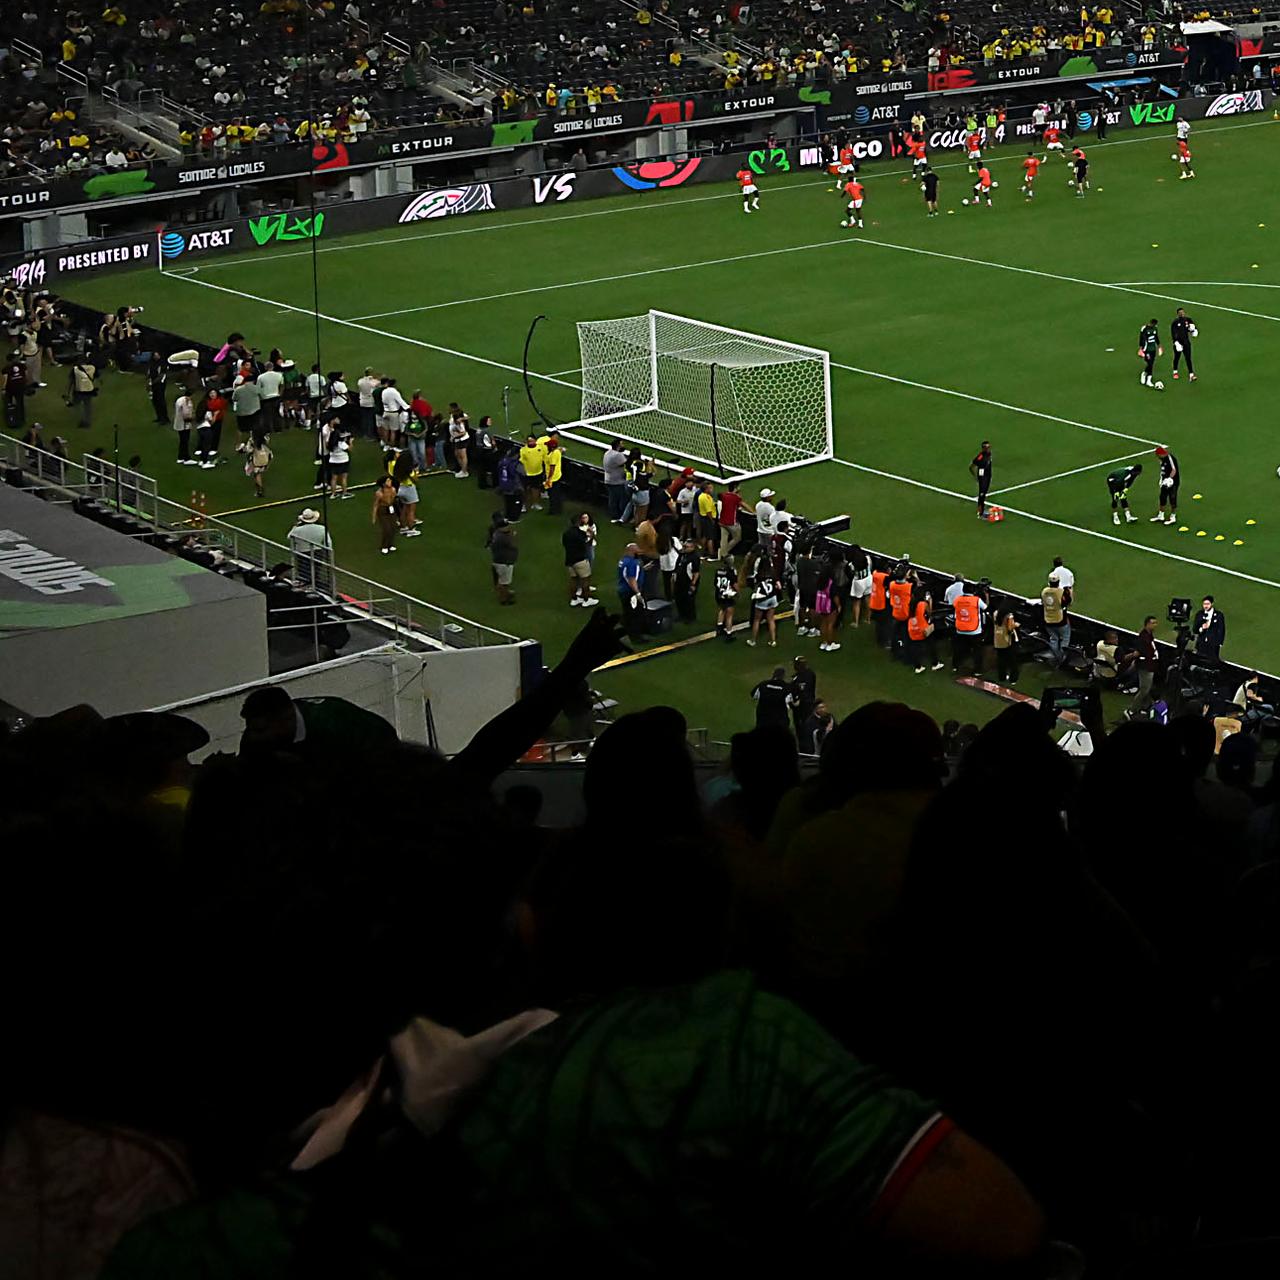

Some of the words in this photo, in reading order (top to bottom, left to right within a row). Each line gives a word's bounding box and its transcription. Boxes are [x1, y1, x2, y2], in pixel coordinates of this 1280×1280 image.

[1138, 52, 1161, 64] AT&T
[871, 104, 901, 120] AT&T
[594, 115, 622, 128] LOCALES
[229, 161, 266, 178] LOCALES
[533, 173, 577, 204] VS
[59, 246, 129, 272] PRESENTED
[134, 243, 150, 259] BY
[188, 228, 234, 251] AT&T
